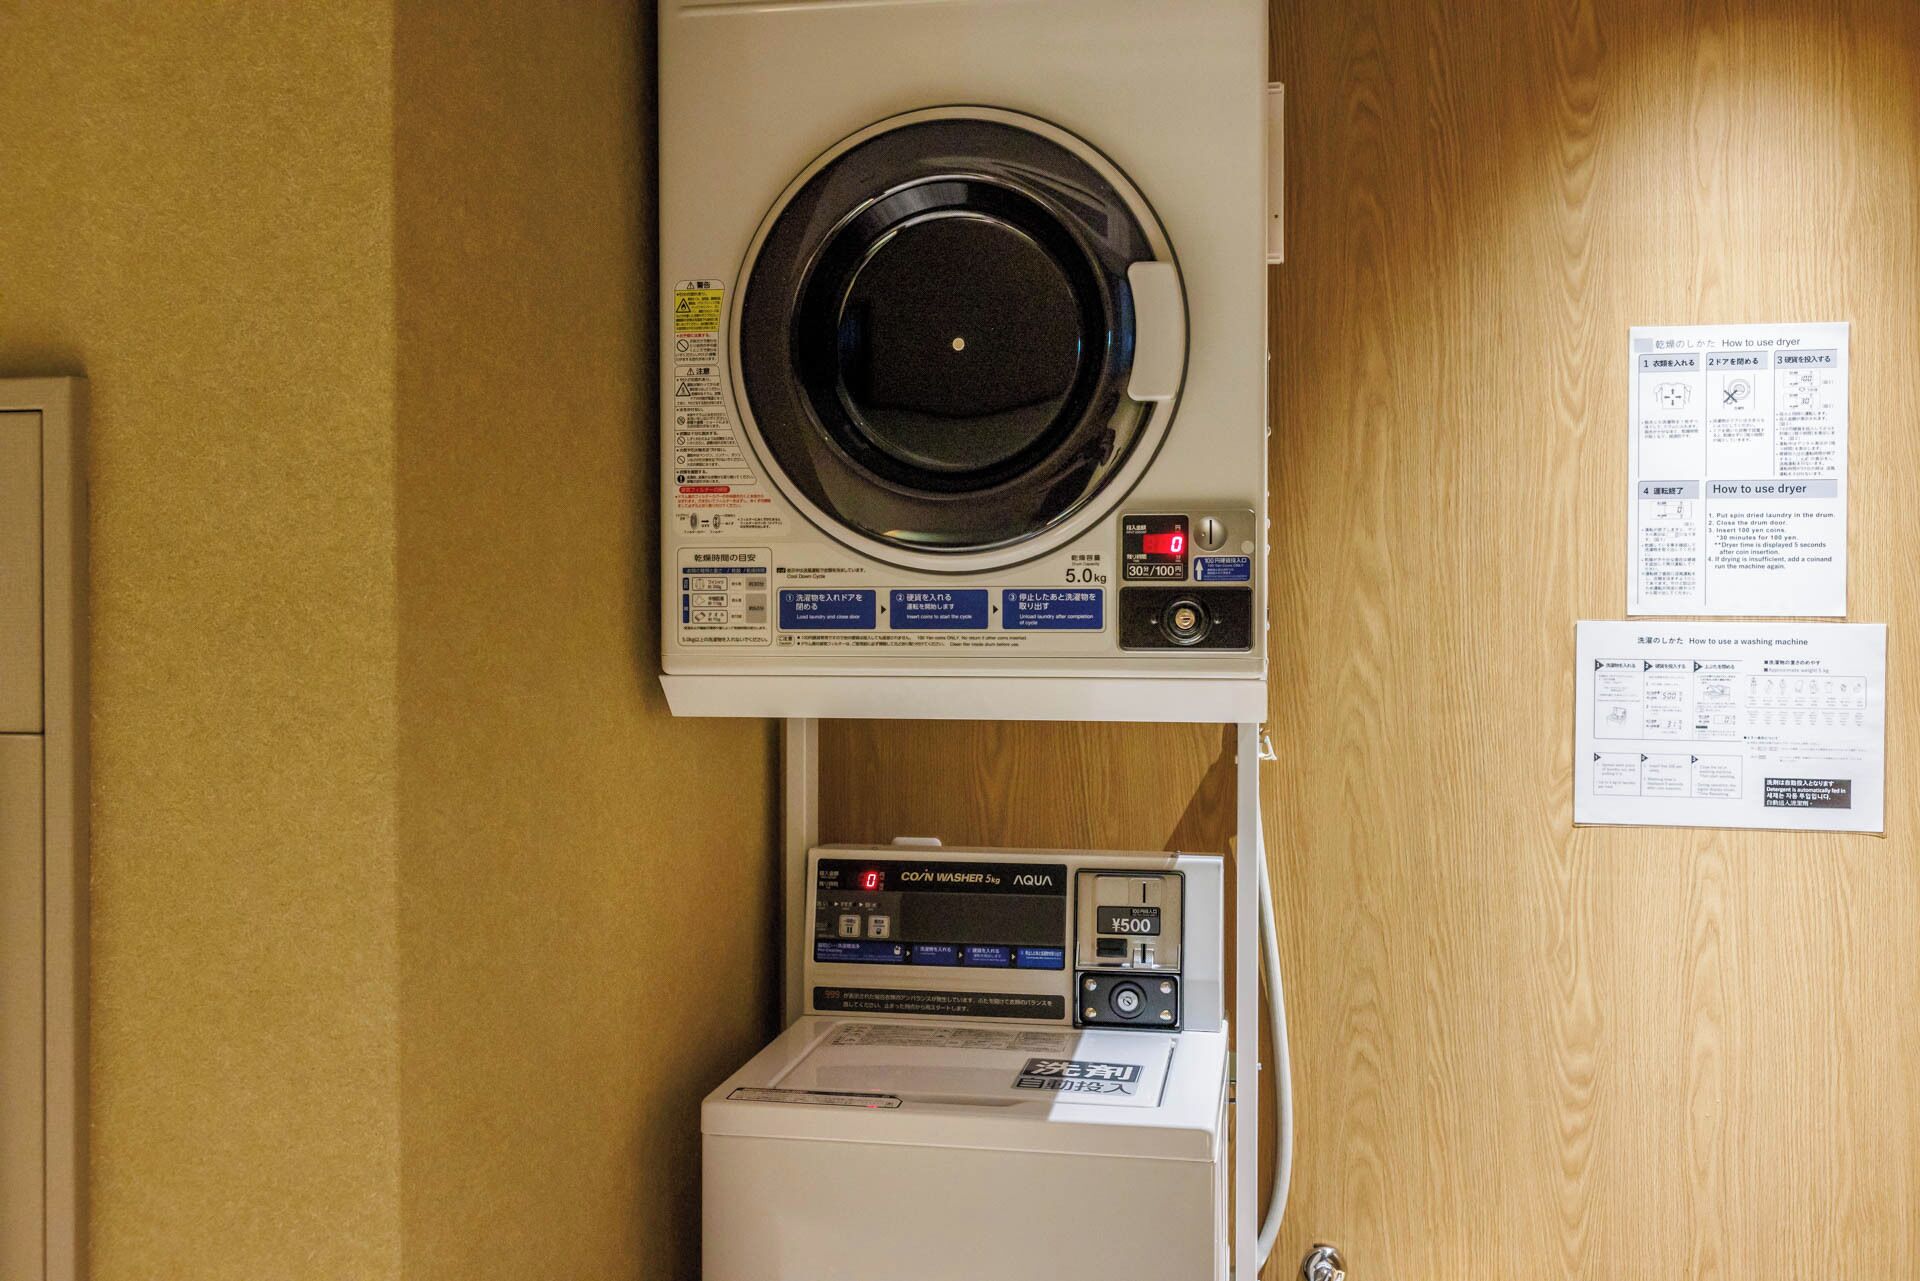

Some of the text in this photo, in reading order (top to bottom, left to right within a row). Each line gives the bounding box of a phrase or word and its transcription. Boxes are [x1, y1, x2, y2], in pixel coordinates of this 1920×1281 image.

[1655, 340, 1716, 350] 乾燥のしかた
[1722, 339, 1742, 348] How
[1745, 339, 1754, 347] to
[1776, 338, 1800, 348] dryer
[1644, 359, 1695, 368] 1 衣類を入れる
[1708, 358, 1758, 366] 2 ドアを閉める
[1777, 356, 1831, 364] 3 硬貨を投入する
[1654, 487, 1684, 495] 運転終了
[1713, 484, 1807, 494] How to use dryer
[1170, 536, 1182, 552] 0
[694, 554, 756, 562] 乾燥時間の目安
[796, 594, 863, 602] 洗濯物を入れドアを
[906, 594, 952, 602] 硬貨を入れる
[1019, 593, 1096, 602] 停止したあと洗濯物を
[796, 602, 818, 611] 閉める
[1018, 602, 1050, 610] 取り出す
[1638, 636, 1684, 644] 洗濯のしかた
[1740, 638, 1773, 647] washing
[1775, 638, 1808, 646] machine
[866, 873, 876, 888] 0
[936, 873, 982, 883] WASHER
[985, 874, 1000, 885] 5kg
[1013, 874, 1052, 886] AQUA
[1112, 918, 1150, 932] ¥500
[1031, 1060, 1132, 1081] 洗剤
[1016, 1078, 1132, 1095] 自動投入
